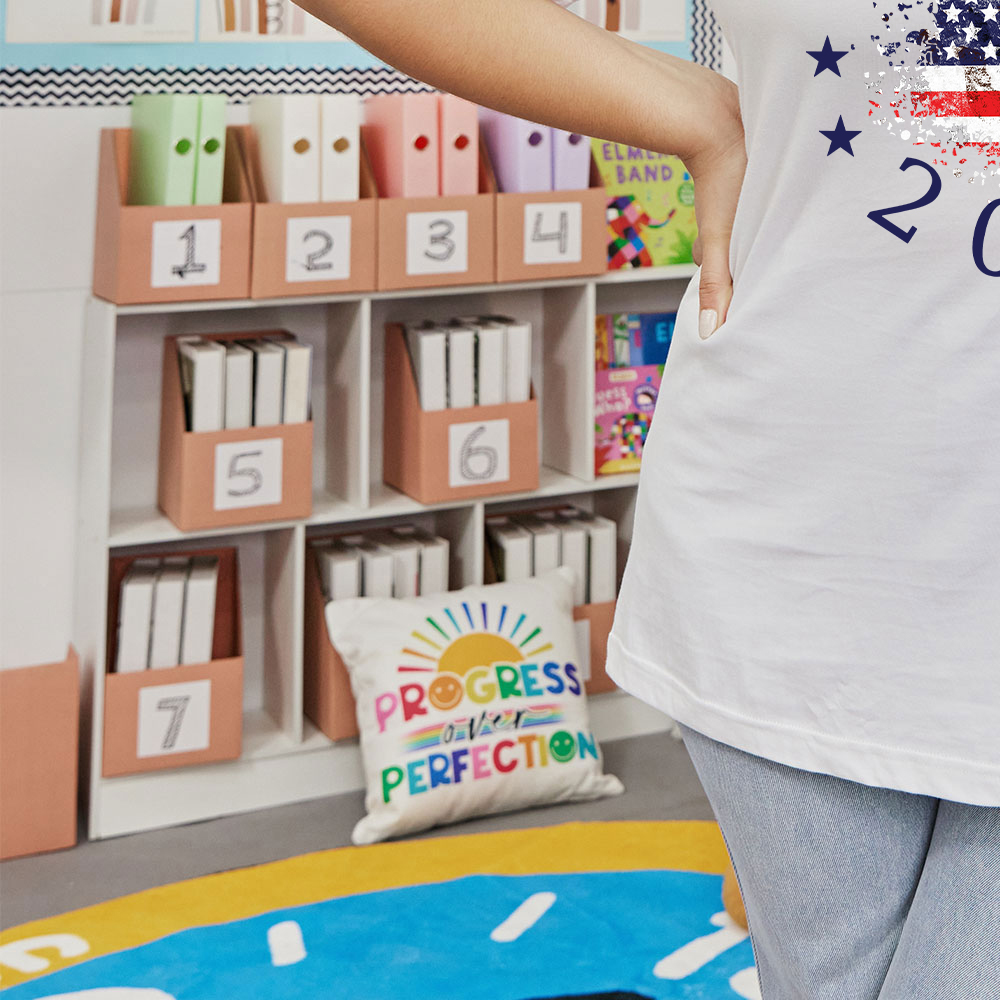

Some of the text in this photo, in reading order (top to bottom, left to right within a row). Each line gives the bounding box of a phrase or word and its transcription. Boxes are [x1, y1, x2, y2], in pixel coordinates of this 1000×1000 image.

[617, 164, 673, 185] BAND
[172, 224, 207, 279] 1
[302, 229, 334, 271] 2
[424, 219, 456, 261] 3
[531, 211, 569, 254] 4
[227, 450, 263, 497] 5
[459, 425, 499, 481] 6
[375, 661, 581, 733] PROGRESS
[155, 695, 190, 750] 7
[442, 708, 528, 743] over
[381, 729, 599, 804] PERFECTION
